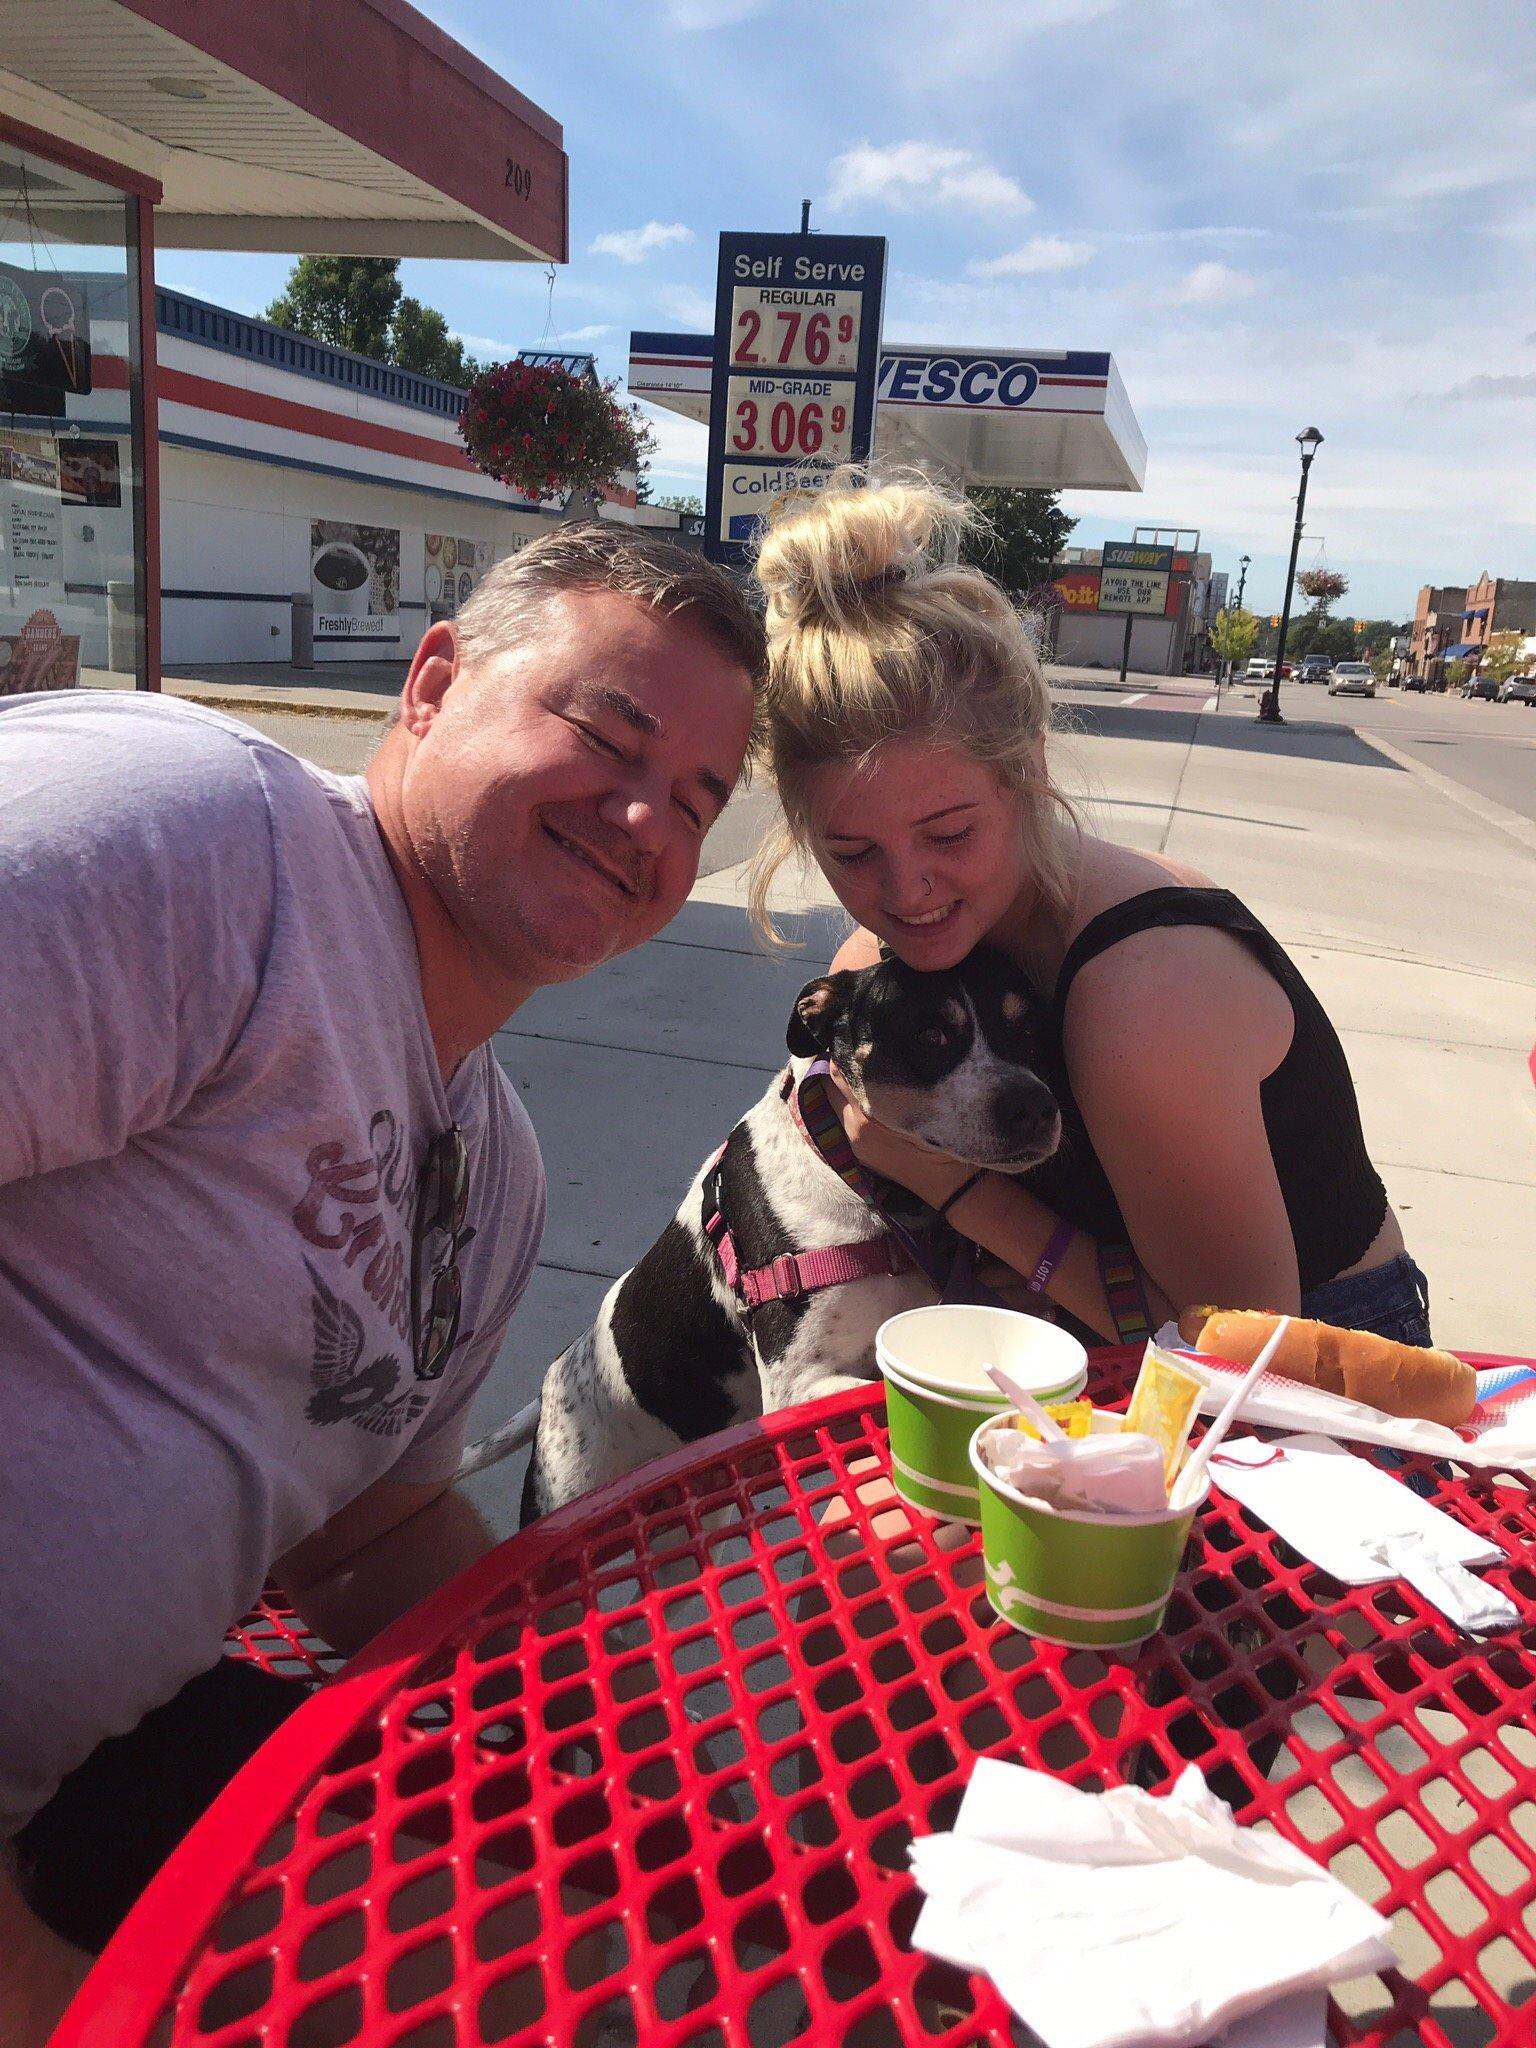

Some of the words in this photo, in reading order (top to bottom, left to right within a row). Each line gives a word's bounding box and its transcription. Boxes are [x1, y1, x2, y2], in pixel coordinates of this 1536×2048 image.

[506, 158, 531, 201] 209
[734, 254, 783, 279] Self
[794, 256, 866, 282] Serve
[759, 289, 836, 307] REGULAR
[748, 379, 832, 397] MID-GRADE
[732, 470, 782, 495] Cold
[1107, 550, 1166, 565] SUBWAY
[1105, 578, 1128, 586] AVOID
[1131, 580, 1144, 588] THE
[1146, 581, 1162, 589] LINE
[1117, 587, 1131, 595] USE
[1137, 588, 1152, 596] OUR
[1103, 593, 1132, 603] REMOTE
[1136, 595, 1152, 604] APP
[25, 627, 58, 639] SANDERS
